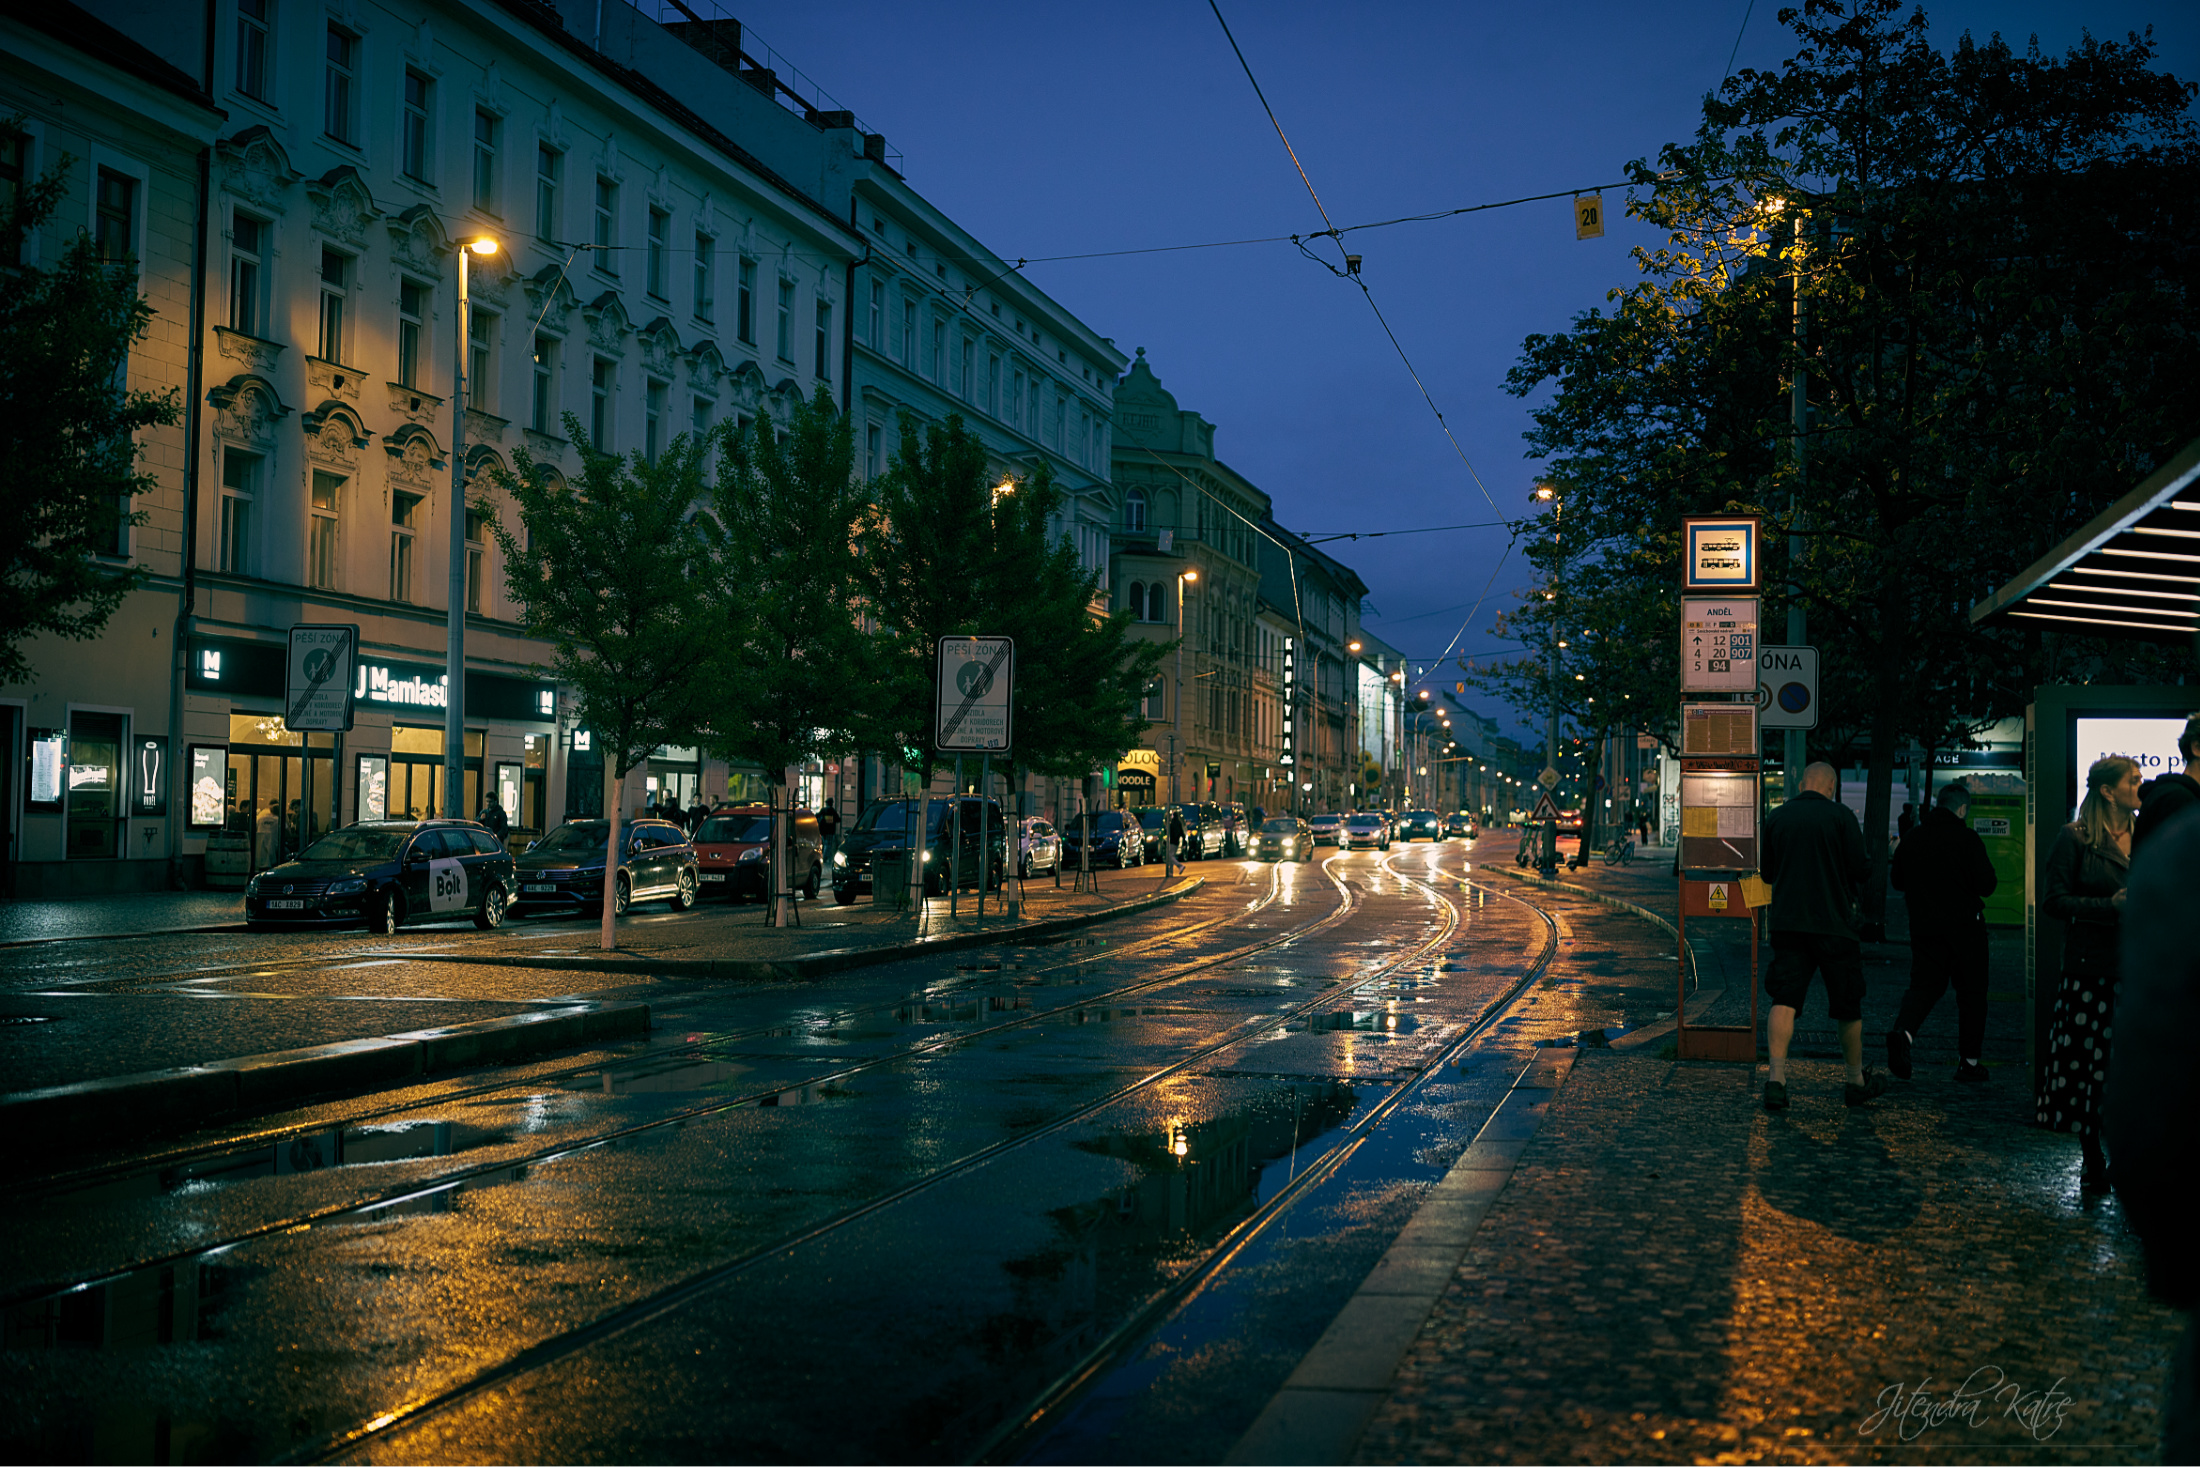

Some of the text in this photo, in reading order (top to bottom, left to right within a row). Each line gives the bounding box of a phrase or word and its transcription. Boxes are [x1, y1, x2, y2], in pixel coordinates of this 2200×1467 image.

[1582, 208, 1597, 226] 20
[1707, 607, 1733, 616] ANDĚL
[295, 632, 317, 643] PĚŠÍ
[1714, 636, 1750, 646] 12 901
[947, 643, 971, 655] PĚŠÍ
[1694, 649, 1751, 659] 4 20 907
[1761, 650, 1802, 670] ÓNA
[1694, 661, 1726, 671] 5 94
[969, 718, 1004, 726] KORIDORECH
[976, 727, 1004, 735] MOTOROVÉ
[960, 736, 986, 744] DOPRAVY
[1118, 776, 1151, 785] NOODLE
[436, 876, 461, 899] Bolt
